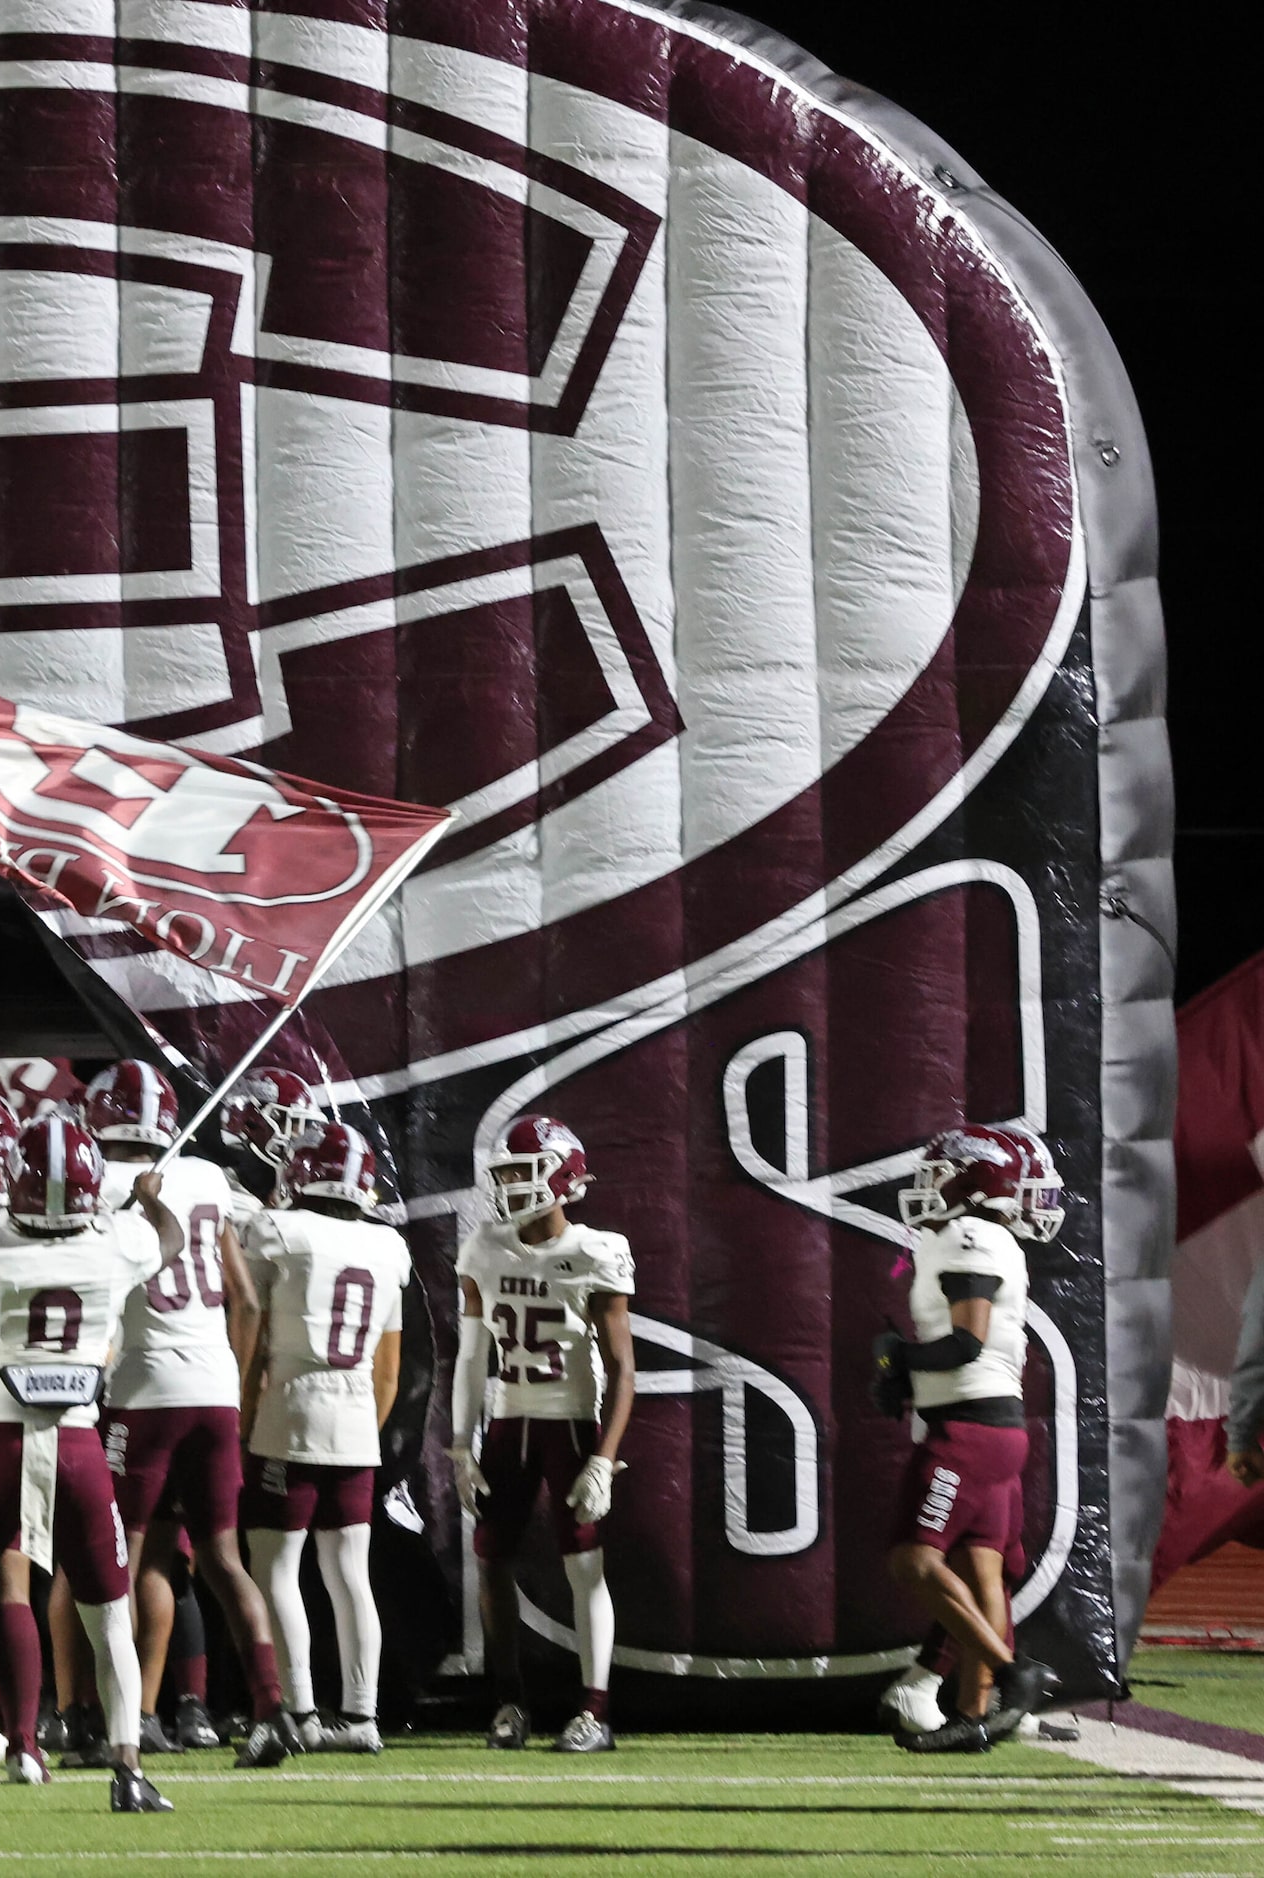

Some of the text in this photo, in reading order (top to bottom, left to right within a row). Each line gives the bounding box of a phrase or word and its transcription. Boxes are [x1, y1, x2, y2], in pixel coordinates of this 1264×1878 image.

[499, 1275, 551, 1298] ENNIS
[327, 1266, 374, 1370] 0
[25, 1372, 88, 1393] DOUGLAS
[916, 1466, 962, 1533] LIONS
